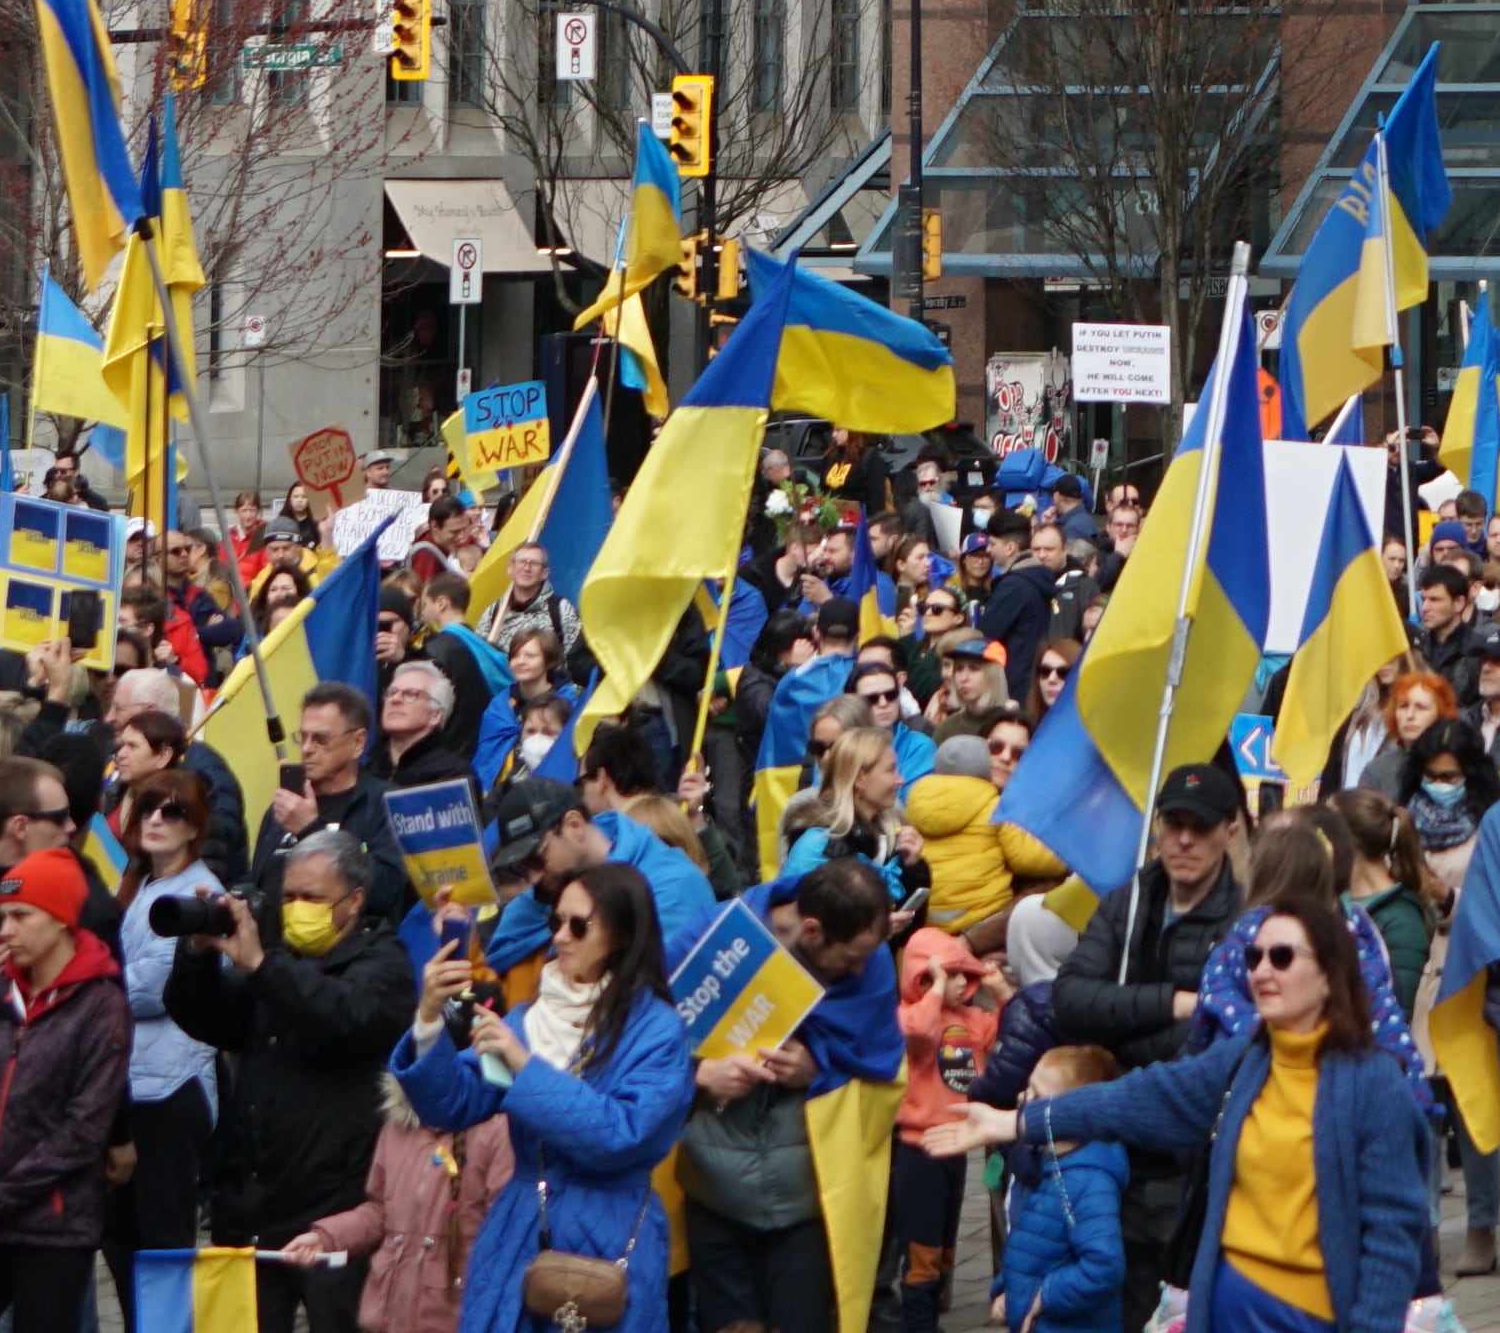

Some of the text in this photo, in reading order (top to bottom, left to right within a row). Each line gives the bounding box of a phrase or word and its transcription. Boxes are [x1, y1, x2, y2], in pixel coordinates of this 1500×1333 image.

[1076, 344, 1120, 353] DESTROY
[1113, 330, 1130, 338] LET
[1080, 386, 1109, 395] AFTER
[1112, 387, 1132, 396] YOU
[1103, 373, 1125, 381] WILL
[1127, 374, 1154, 382] COME
[476, 387, 540, 422] STOP
[303, 443, 350, 472] PUTIN
[479, 429, 542, 464] WAR
[314, 458, 348, 483] NOW
[393, 800, 473, 835] Stand with
[676, 937, 750, 1027] Stop the
[725, 993, 776, 1049] WAR
